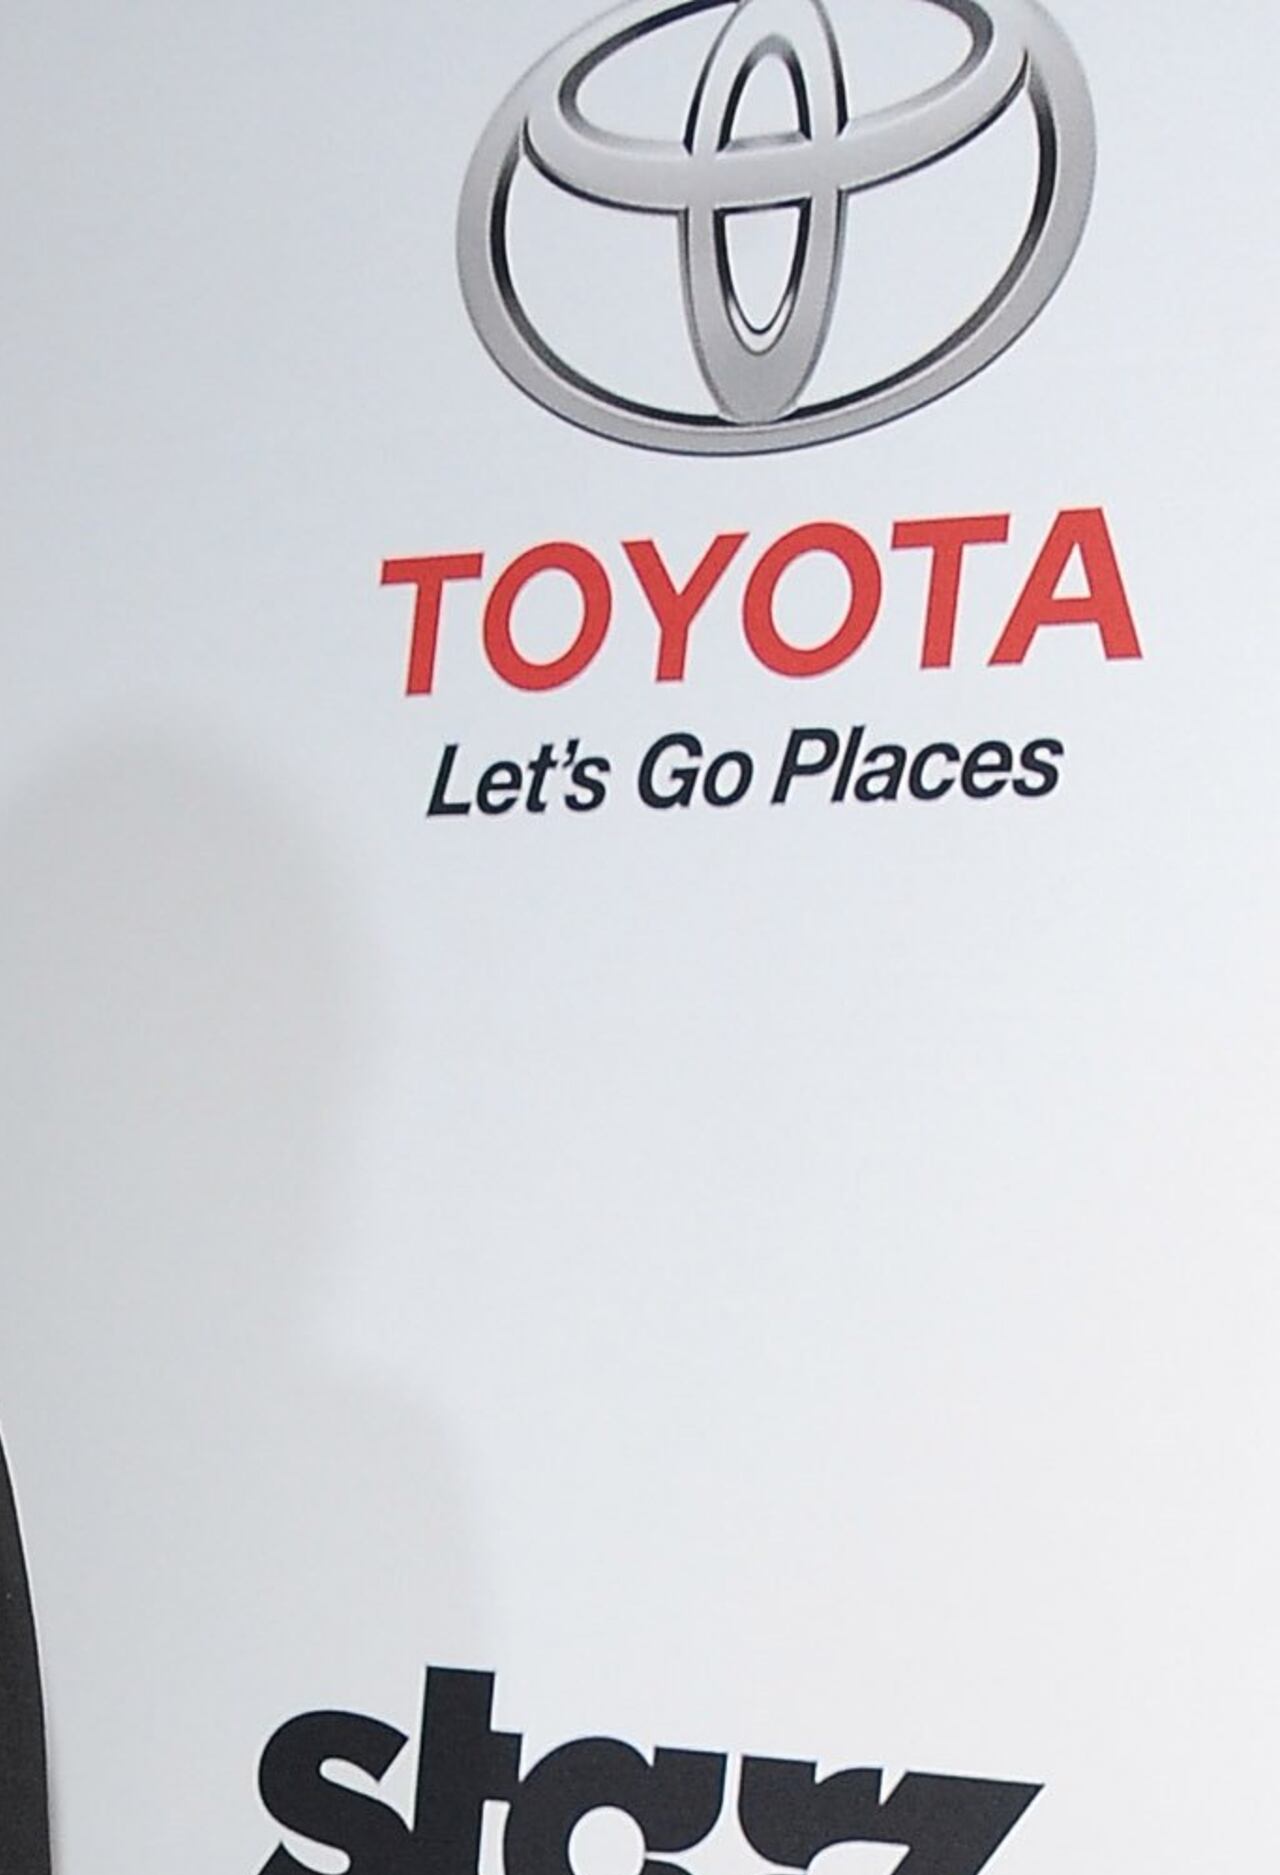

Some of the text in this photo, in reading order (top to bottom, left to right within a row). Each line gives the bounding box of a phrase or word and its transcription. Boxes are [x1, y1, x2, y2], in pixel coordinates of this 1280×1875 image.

[380, 507, 1142, 697] TOYOTA
[426, 724, 1065, 818] Let's Go Places
